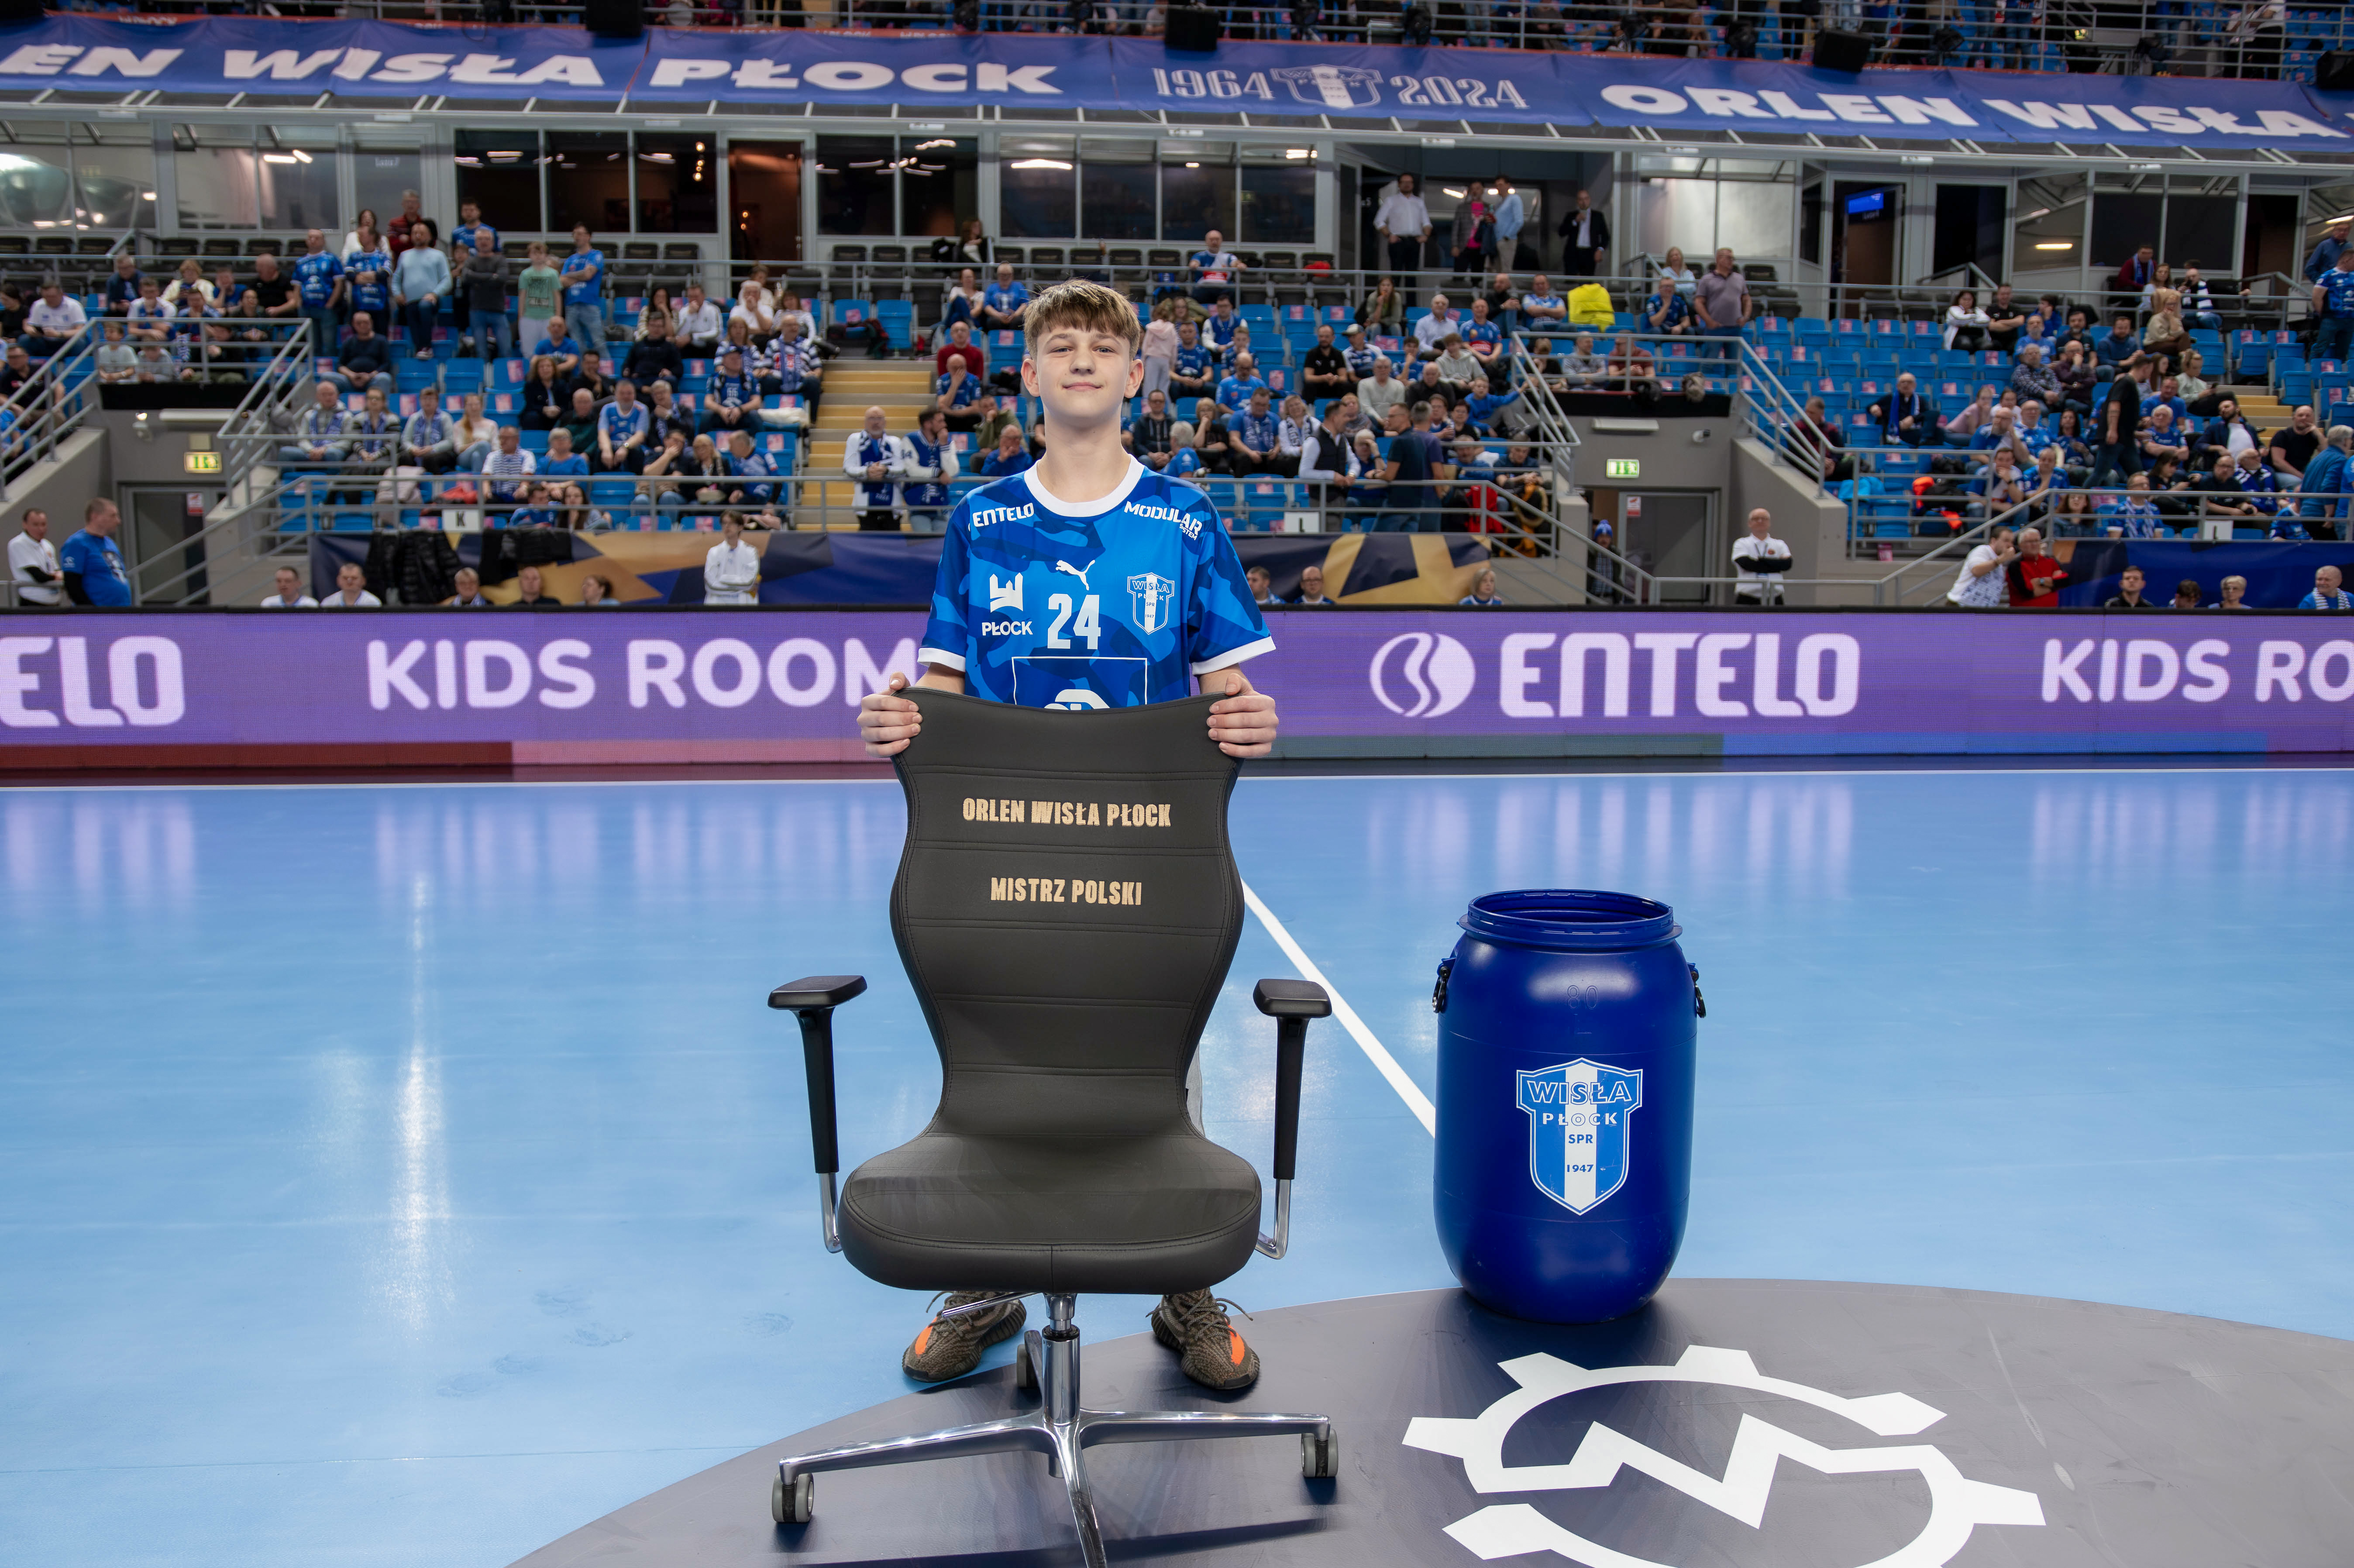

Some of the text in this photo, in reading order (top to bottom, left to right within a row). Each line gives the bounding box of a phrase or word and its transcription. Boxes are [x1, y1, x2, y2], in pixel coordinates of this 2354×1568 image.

[0, 44, 1063, 94] EN WISŁA PŁOCK
[1151, 68, 1274, 100] 1964
[1390, 75, 1529, 109] 2024
[1600, 84, 2351, 138] ORLEN WISŁA
[455, 511, 466, 527] K
[972, 502, 1034, 527] ENTELO
[1124, 501, 1202, 536] MODULAR
[1132, 581, 1170, 593] WISŁA
[981, 621, 1033, 636] PŁOCK
[1047, 593, 1101, 650] 24
[0, 635, 186, 727] ELO
[367, 638, 916, 710] KIDS ROOM
[1499, 632, 1861, 718] ENTELO
[2041, 639, 2354, 702] KIDS RO
[962, 798, 1171, 827] ORLEN WISŁA PŁOCK
[990, 877, 1142, 905] MISTRZ POLSKI
[1566, 985, 1599, 1010] 80
[1526, 1080, 1633, 1105] WISŁA
[1542, 1112, 1618, 1126] PŁOCK
[1568, 1134, 1593, 1144] SPR
[1566, 1164, 1594, 1173] 1947
